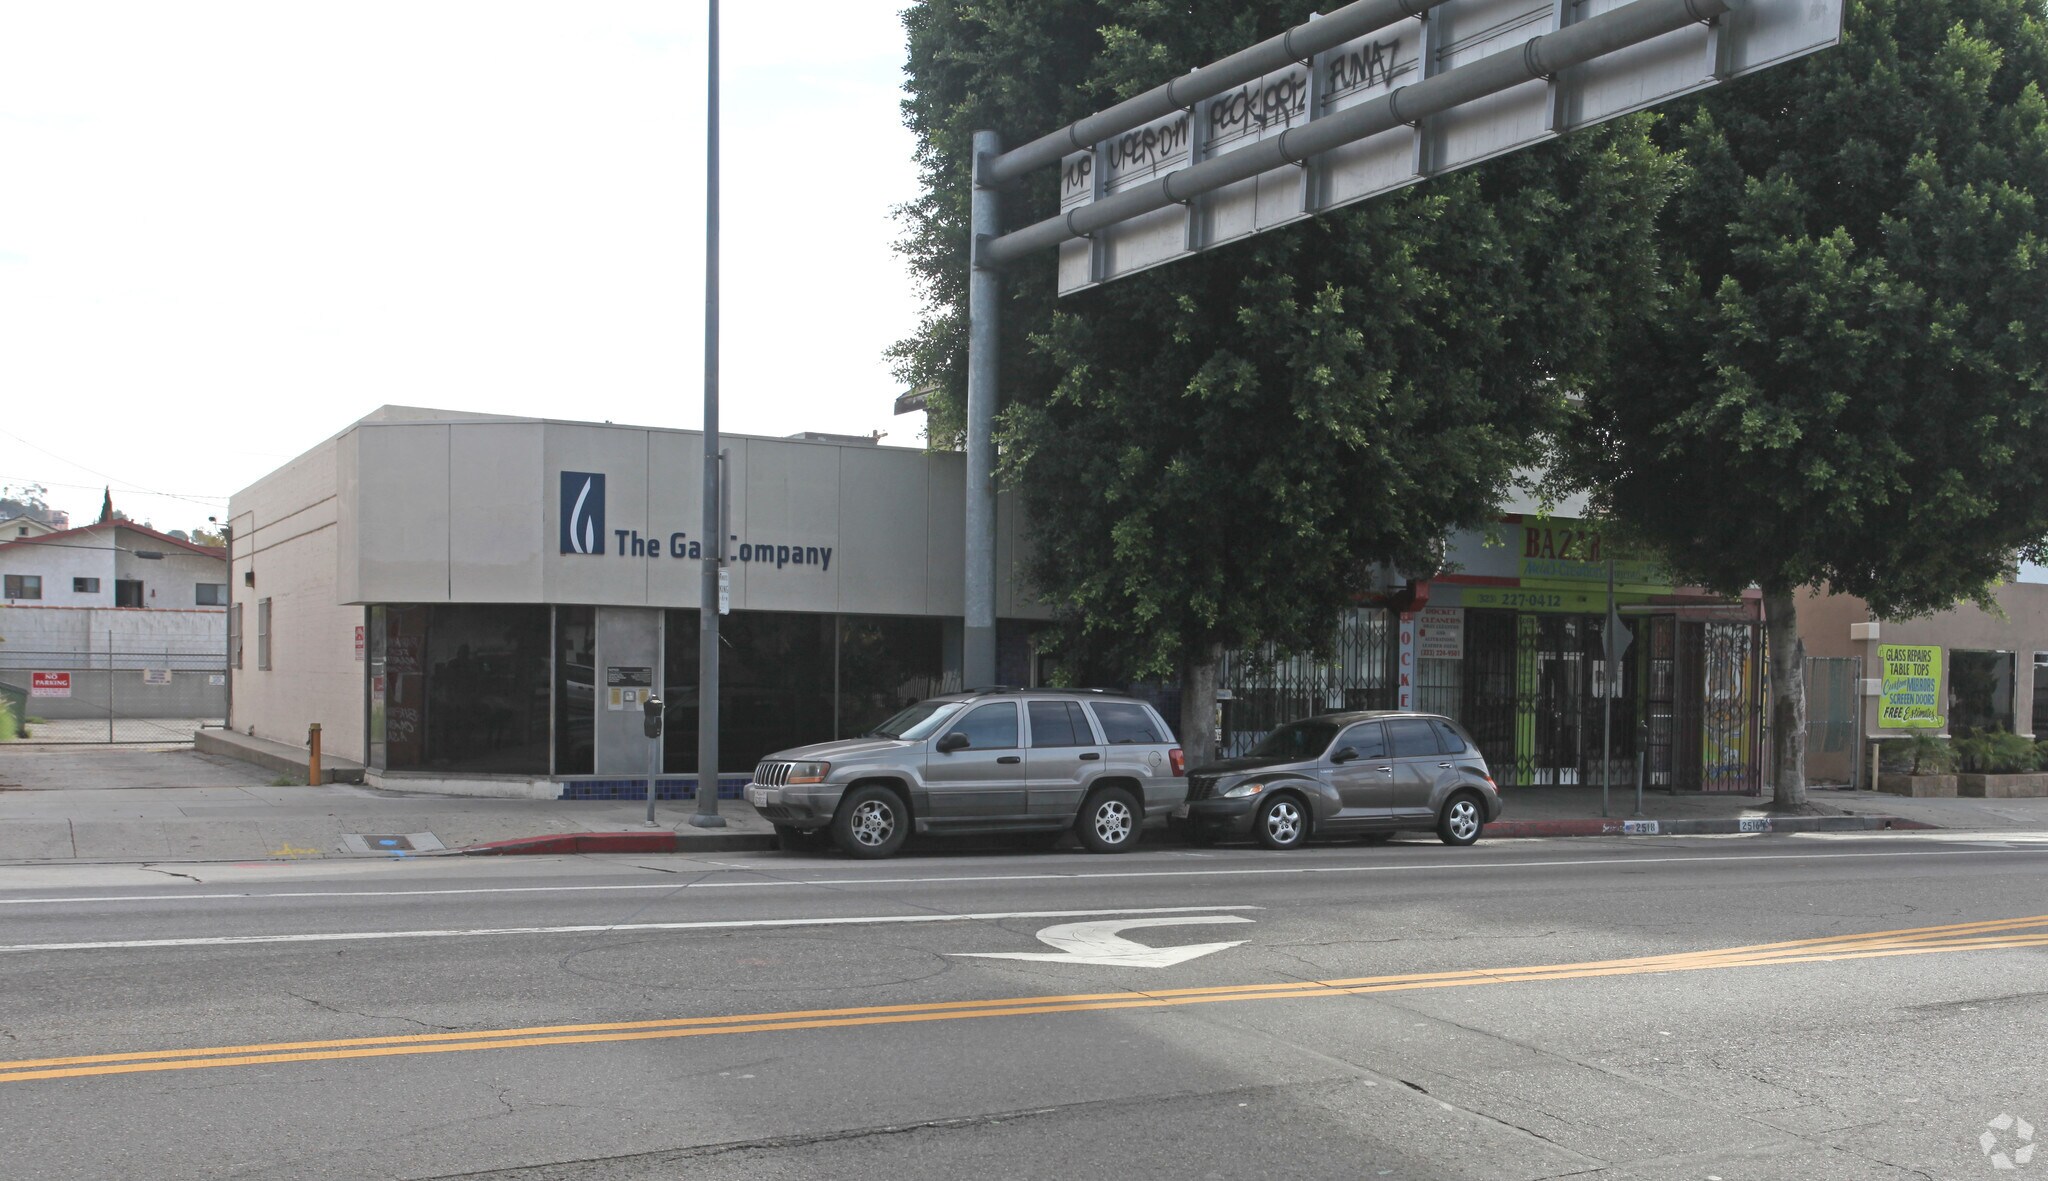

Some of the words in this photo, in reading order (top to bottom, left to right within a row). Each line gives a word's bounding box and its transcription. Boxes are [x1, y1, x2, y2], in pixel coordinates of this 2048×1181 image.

[615, 529, 660, 558] The
[669, 532, 701, 560] Ga
[1503, 593, 1562, 608] 227-0412
[1400, 612, 1412, 709] ROCKE
[1886, 648, 1907, 662] GLASS
[1907, 649, 1932, 663] REPAIRS
[1890, 662, 1910, 676] TABLE
[1913, 663, 1930, 676] TOPS
[1906, 677, 1935, 693] MIRRORS
[1915, 694, 1935, 706] DOORS
[1884, 706, 1904, 719] FREE
[1636, 822, 1656, 832] 2518
[1742, 821, 1760, 831] 2516
